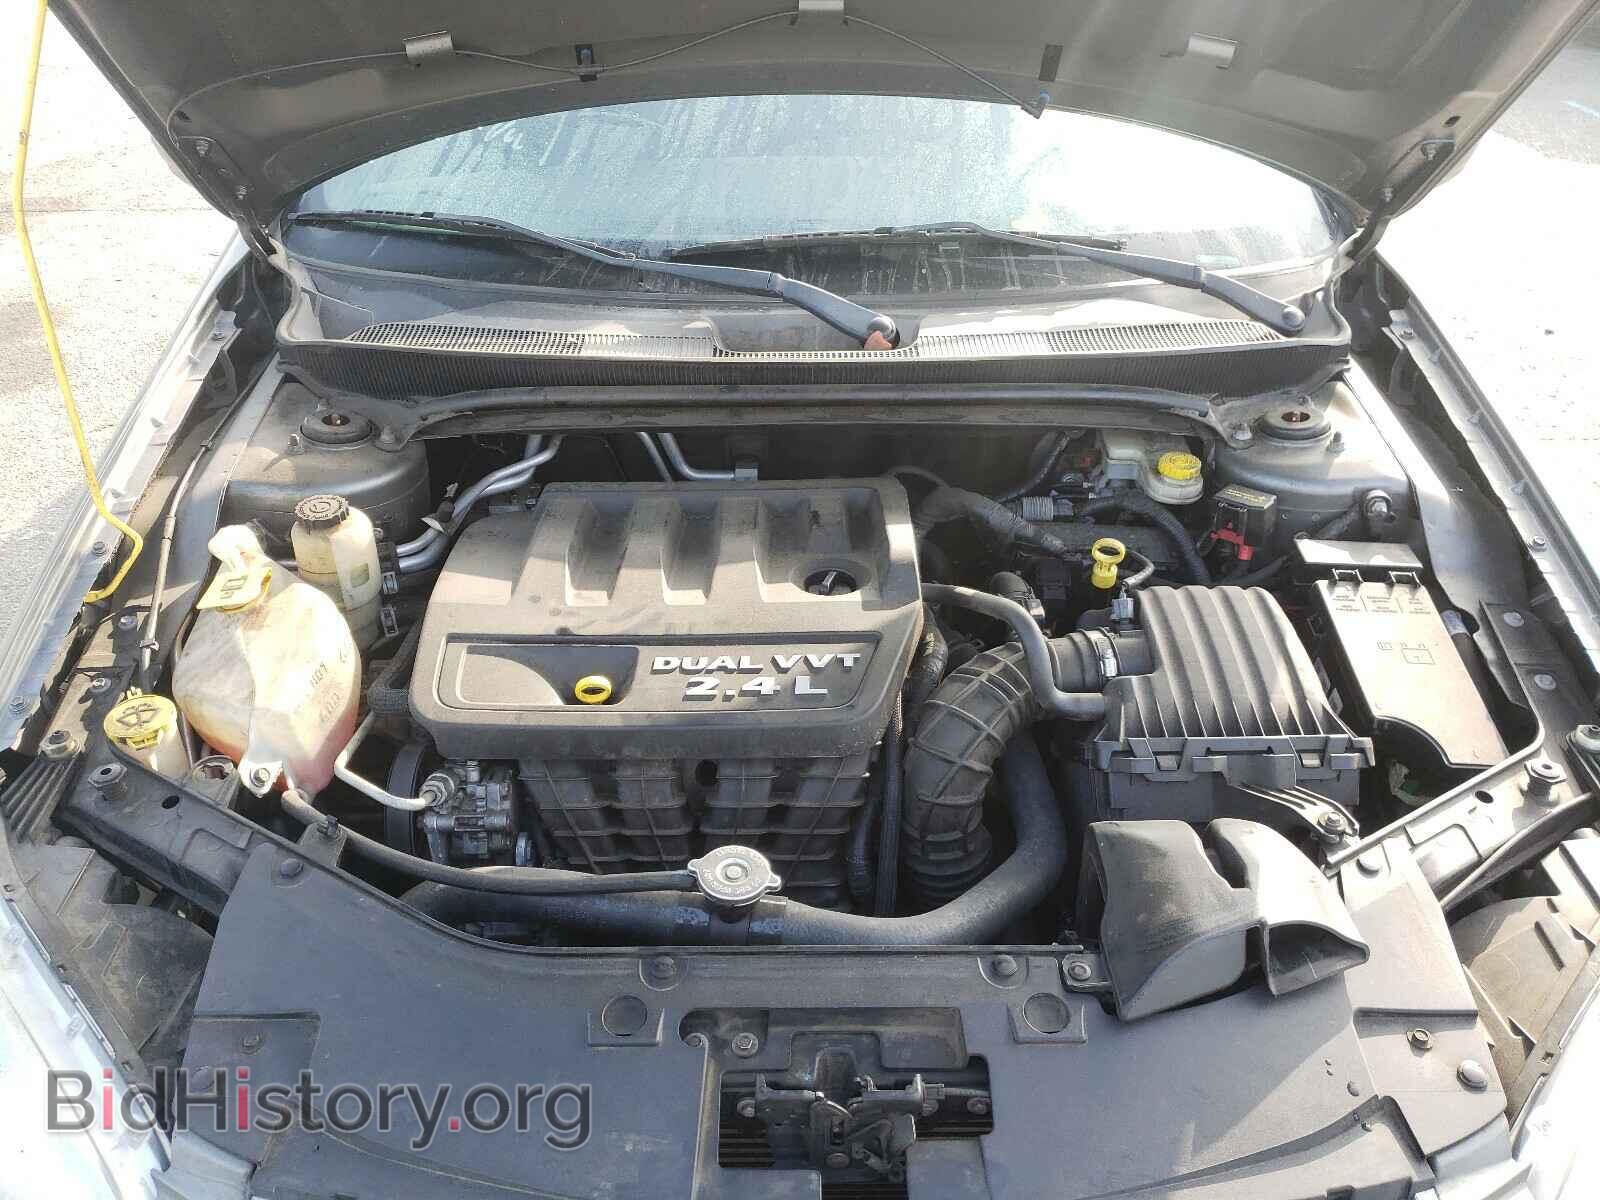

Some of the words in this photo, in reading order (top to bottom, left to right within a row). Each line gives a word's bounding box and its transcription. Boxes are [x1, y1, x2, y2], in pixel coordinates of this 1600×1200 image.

[652, 654, 764, 675] DUAL
[770, 652, 861, 674] VVT
[683, 675, 781, 701] 2.4
